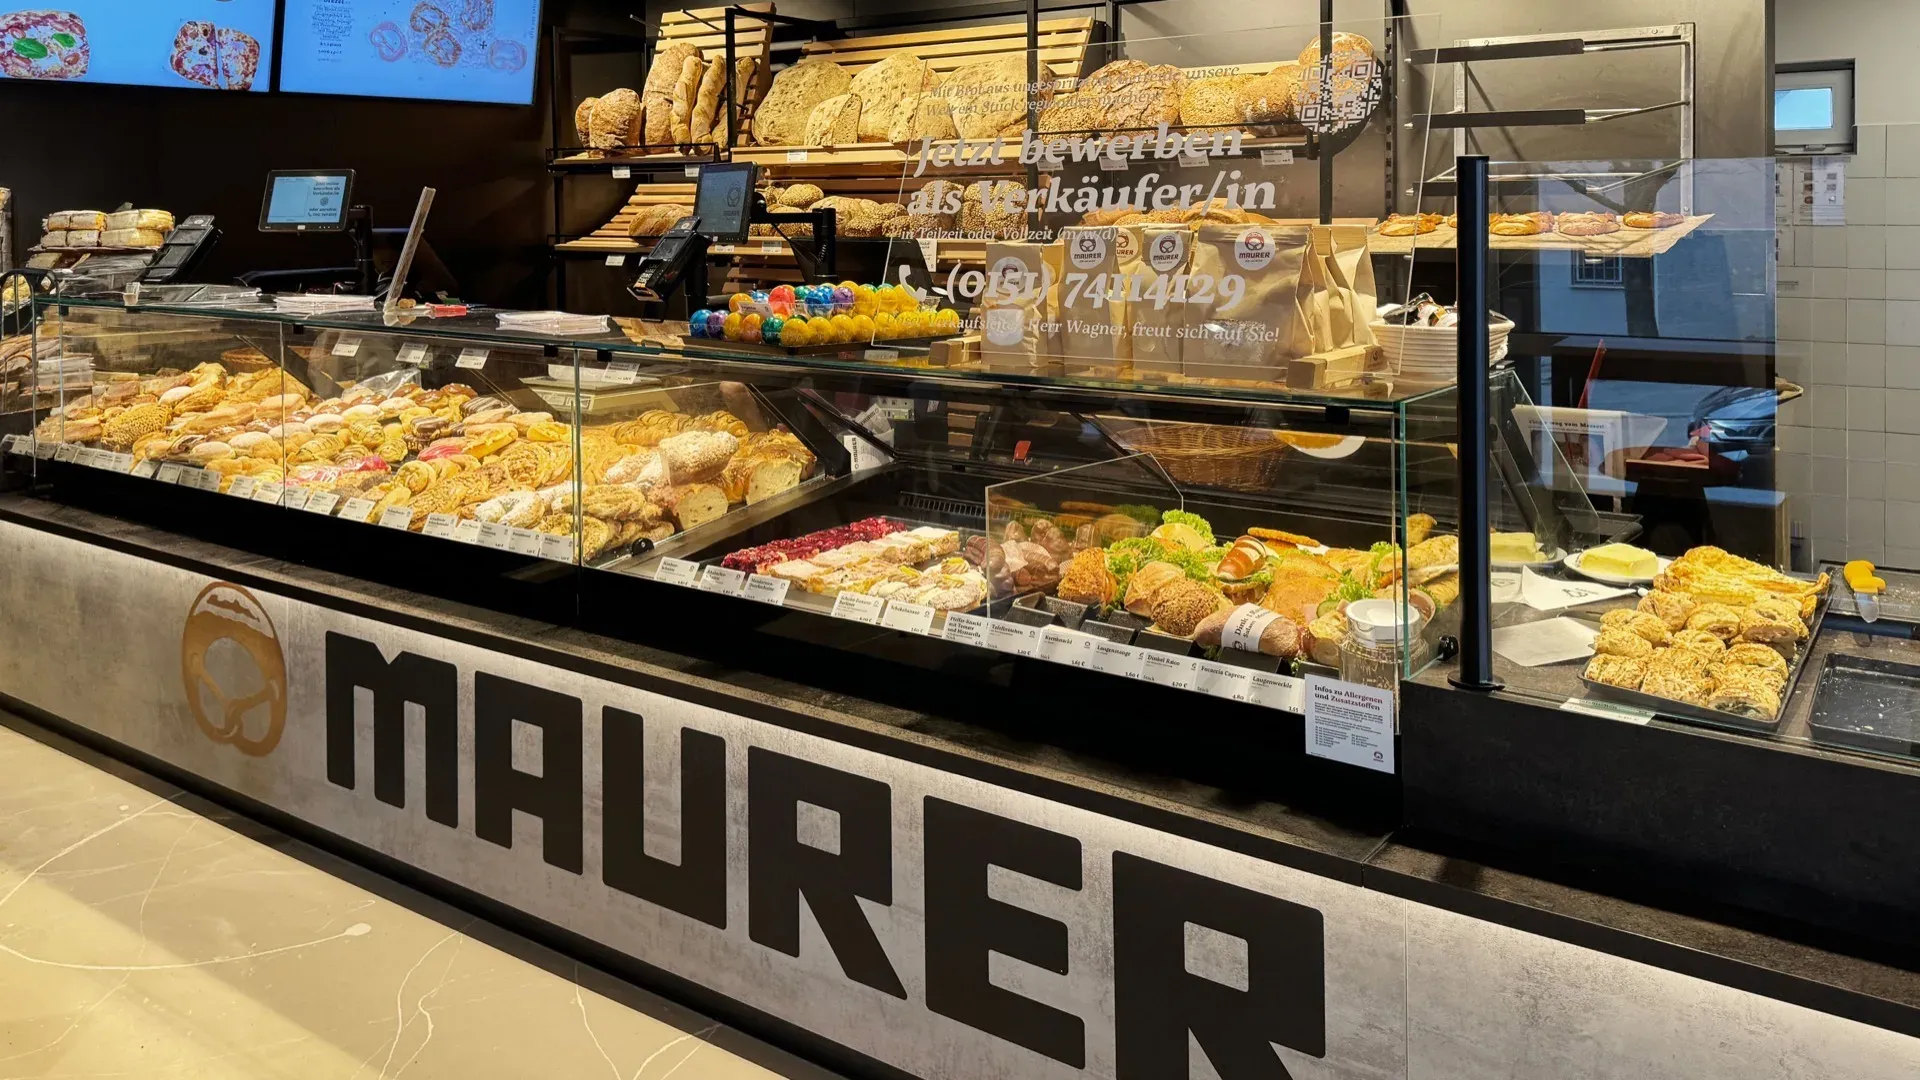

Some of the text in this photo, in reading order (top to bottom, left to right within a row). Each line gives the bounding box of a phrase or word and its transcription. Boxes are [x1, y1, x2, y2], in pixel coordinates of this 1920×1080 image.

[929, 86, 952, 98] Mit
[954, 84, 985, 97] Brot
[986, 84, 1011, 94] aus
[1185, 66, 1241, 80] unsere
[958, 103, 978, 114] ein
[981, 99, 1022, 113] Stück
[912, 122, 1243, 178] Jetzt bewerben
[907, 170, 1276, 217] als Verkäufer/in
[901, 225, 1119, 242] in Teilzeit oder Vollzeit (m/w/d)
[1153, 253, 1180, 261] MAURER
[947, 261, 1246, 313] (0151) 74114129
[1028, 319, 1063, 333] Herr
[1066, 320, 1127, 340] Wagner,
[1131, 321, 1173, 339] freut
[1175, 324, 1210, 340] sich
[1213, 325, 1244, 344] auf
[1246, 327, 1280, 343] Sie!
[1096, 644, 1132, 657] Laugenstange
[1201, 665, 1247, 681] Focaccia Caprese
[1252, 675, 1293, 690] Laugenweckle
[1314, 684, 1333, 694] Infos
[1344, 690, 1383, 704] Allergenen
[1314, 693, 1381, 711] und Zusatzstoffen
[326, 629, 1327, 1080] MAURER
